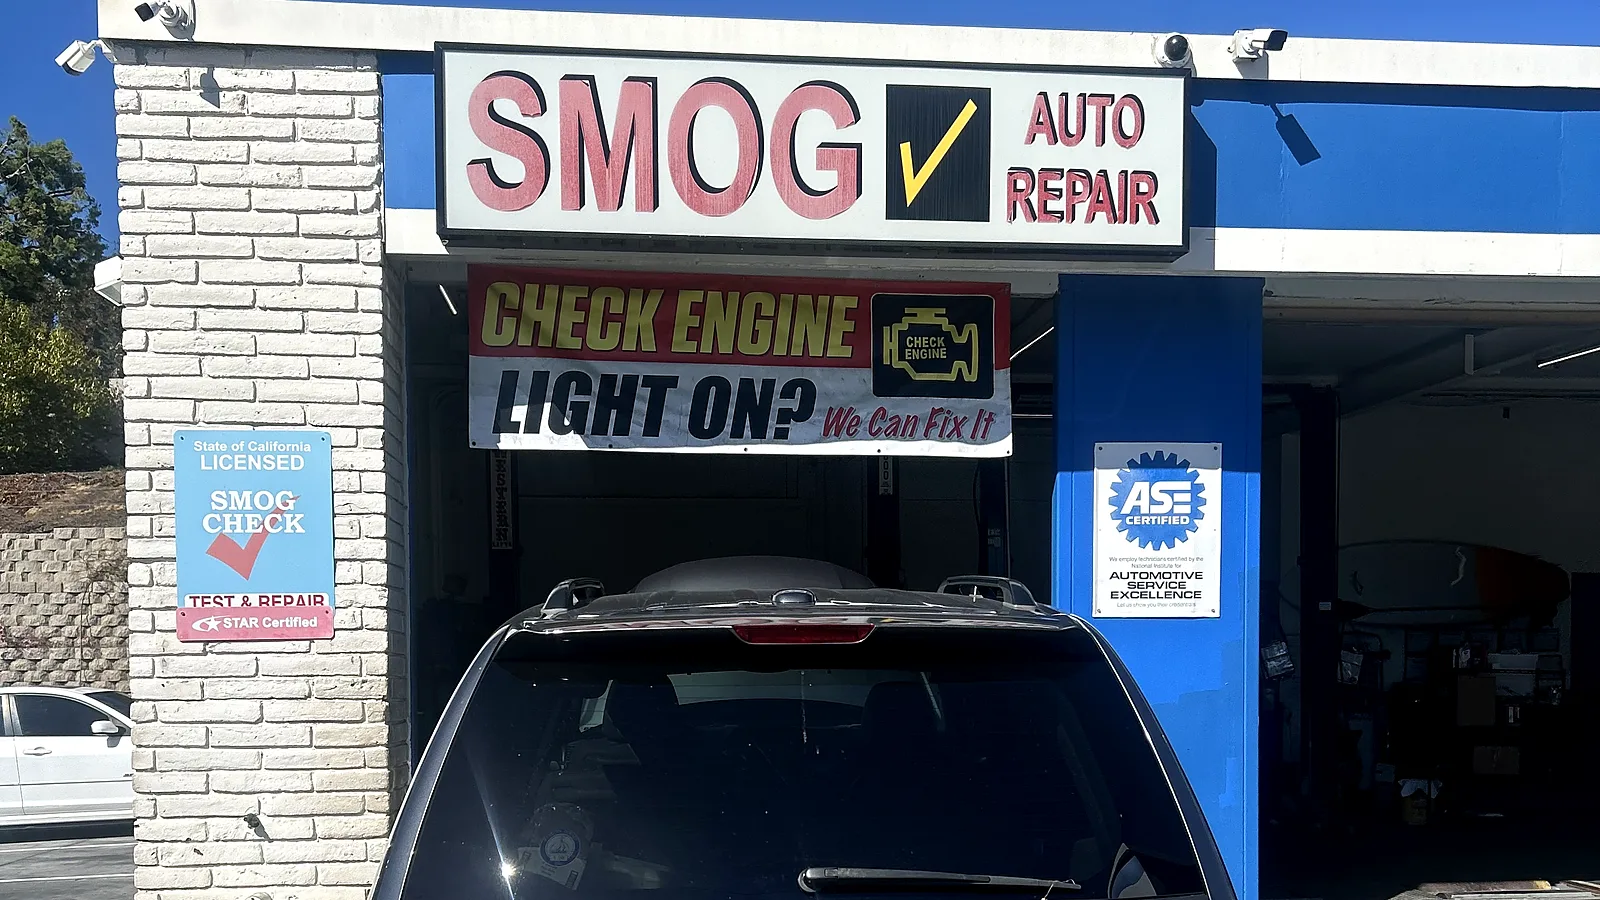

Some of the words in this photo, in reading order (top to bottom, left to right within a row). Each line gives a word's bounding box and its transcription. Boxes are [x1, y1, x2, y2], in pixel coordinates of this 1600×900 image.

[1024, 92, 1146, 149] AUTO
[467, 71, 862, 220] SMOG
[1006, 166, 1160, 226] REPAIR
[481, 281, 665, 352] CHECK
[670, 289, 859, 359] ENGINE
[906, 336, 946, 348] CHECK
[905, 347, 947, 360] ENGINE
[492, 369, 680, 438] LIGHT
[686, 375, 818, 440] ON?
[822, 406, 862, 439] We
[868, 406, 920, 439] Can
[923, 406, 968, 440] Fix
[970, 408, 995, 440] It
[193, 440, 228, 452] State
[231, 440, 245, 452] of
[247, 440, 312, 452] California
[200, 454, 305, 471] LICENSED
[210, 490, 296, 511] SMOG
[1120, 480, 1192, 515] ASE
[202, 513, 306, 534] CHECK
[1125, 515, 1190, 525] CERTIFIED
[1109, 571, 1204, 580] AUTOMOTIVE
[1126, 581, 1187, 590] SERVICE
[189, 595, 235, 607] TEST
[258, 594, 325, 606] REPAIR
[1110, 590, 1202, 600] EXCELLENCE
[223, 616, 260, 629] STAR
[262, 616, 318, 628] Certified
